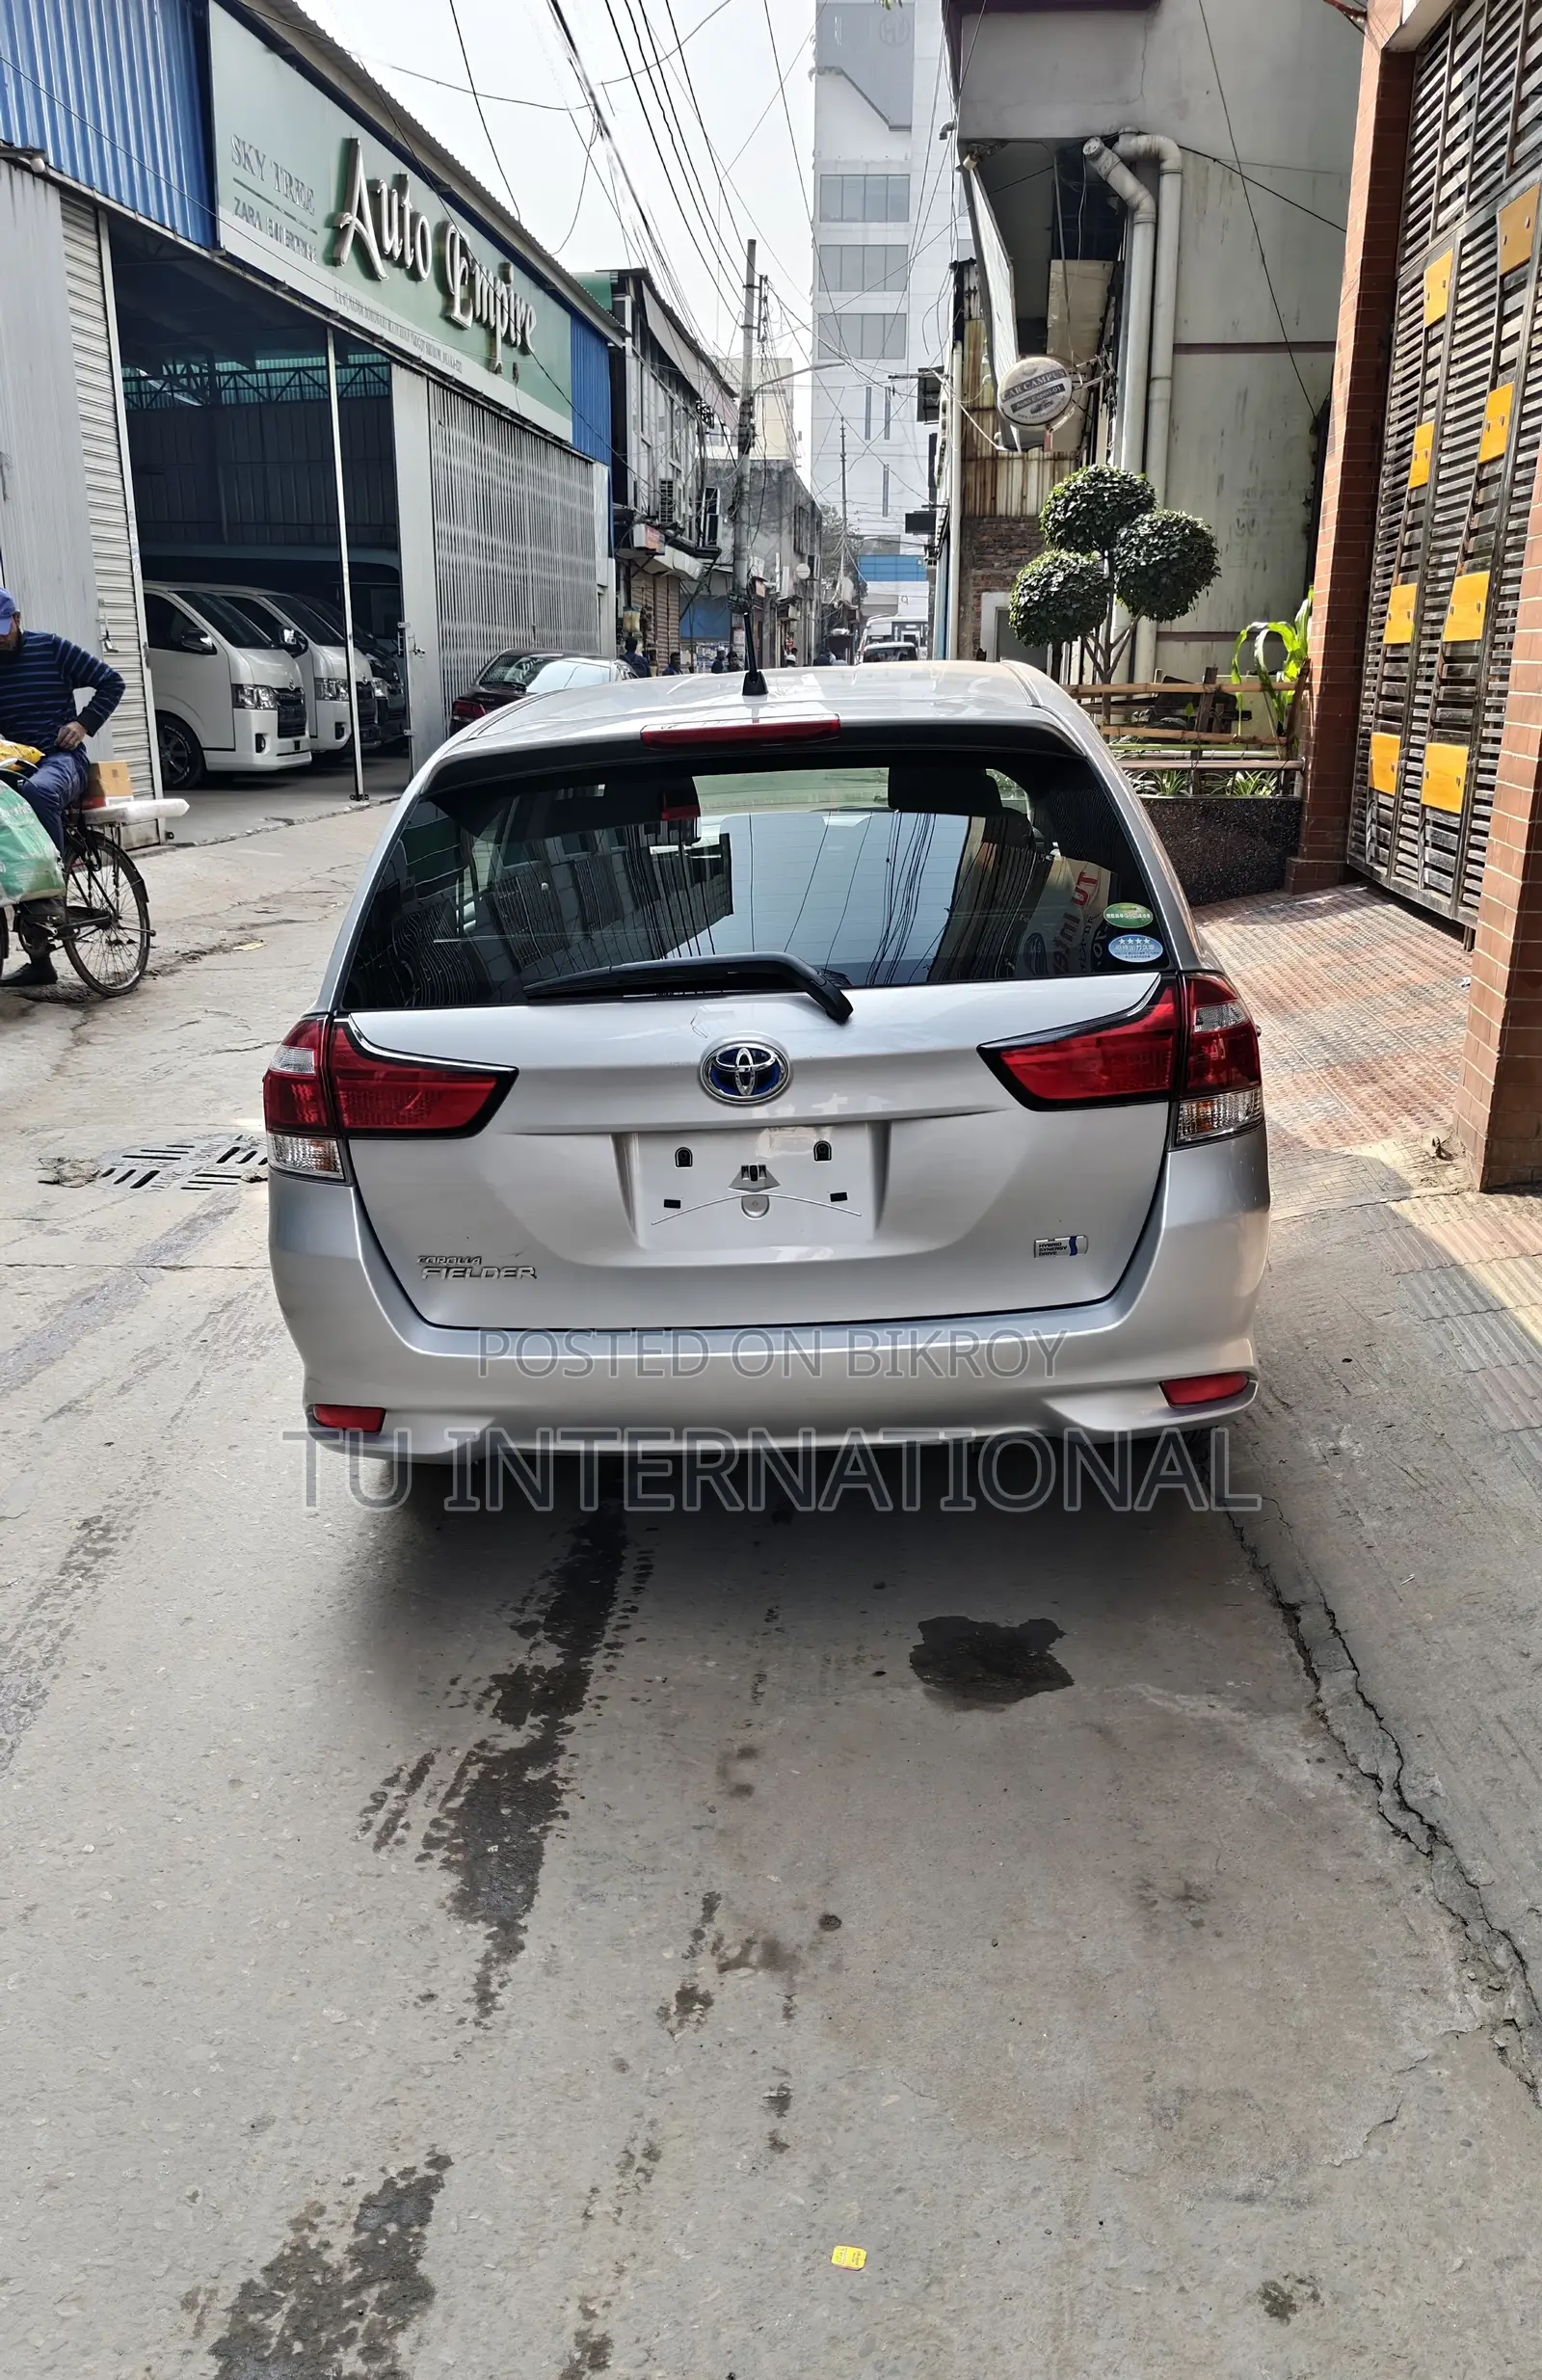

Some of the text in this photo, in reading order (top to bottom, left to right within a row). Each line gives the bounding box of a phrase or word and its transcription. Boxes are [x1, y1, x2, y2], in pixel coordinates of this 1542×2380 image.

[230, 134, 266, 181] SKY
[233, 196, 263, 231] ZARA
[333, 137, 433, 282] Auto
[443, 222, 537, 374] Empire
[1002, 387, 1023, 401] CAR
[1024, 369, 1065, 390] CAMPUS
[416, 1255, 482, 1266] COROLLA
[421, 1266, 538, 1280] FIELDER
